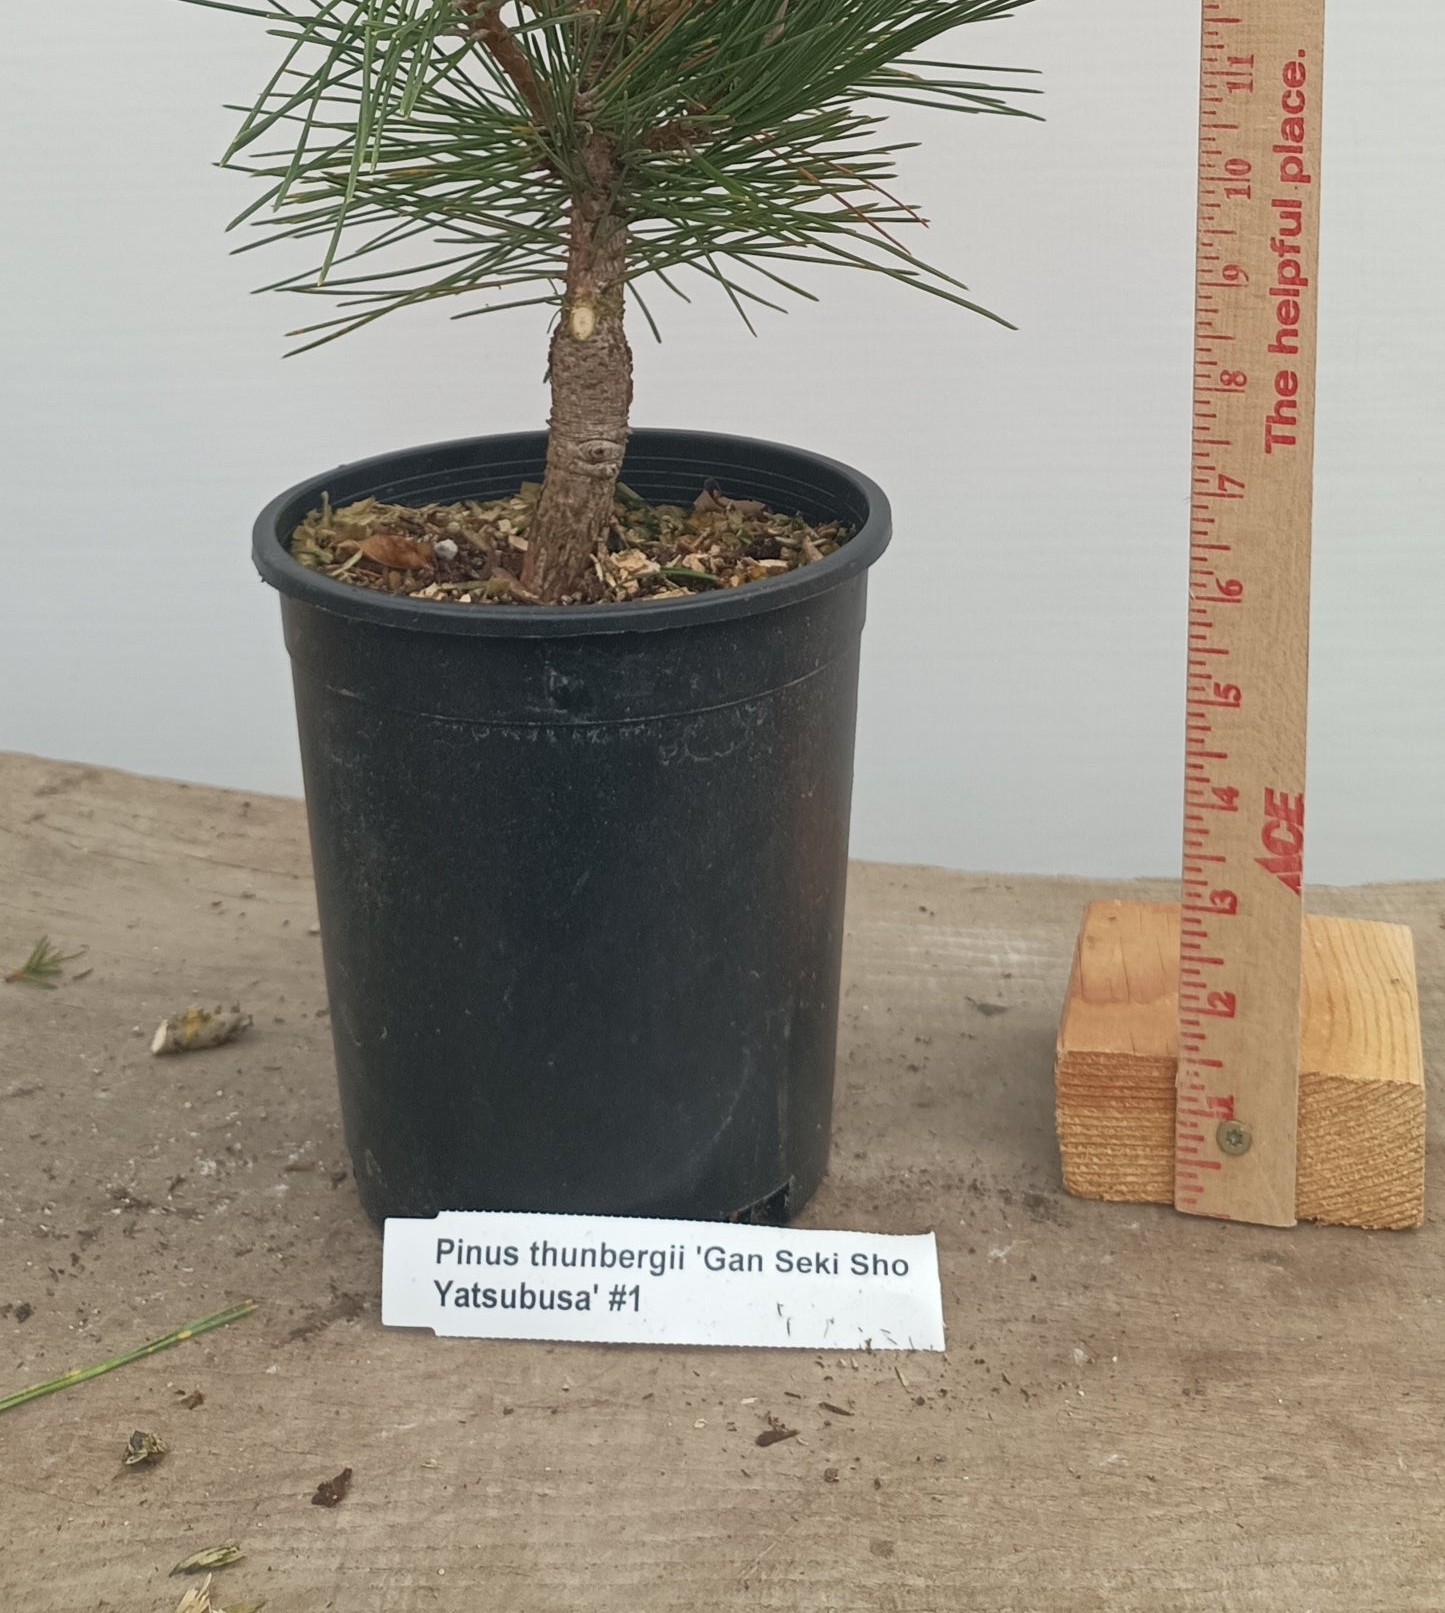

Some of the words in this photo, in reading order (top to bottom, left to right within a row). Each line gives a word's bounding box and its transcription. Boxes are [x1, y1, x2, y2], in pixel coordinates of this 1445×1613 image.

[1226, 54, 1255, 93] 11
[1272, 49, 1311, 184] place.
[1224, 158, 1252, 199] 10
[1222, 264, 1249, 283] 9
[1268, 199, 1309, 355] helpful
[1219, 370, 1247, 387] 8
[1264, 370, 1299, 454] The
[1217, 473, 1245, 492] 7
[1215, 579, 1243, 597] 6
[1213, 682, 1242, 702] 5
[1254, 787, 1304, 896] ACE
[436, 1238, 519, 1266] Pinus
[530, 1240, 685, 1277] thunbergii
[696, 1246, 763, 1272] 'Gan
[775, 1249, 839, 1275] Seki
[850, 1253, 909, 1276] Sho
[433, 1279, 599, 1311] Yatsubusa'
[608, 1284, 640, 1312] #1
